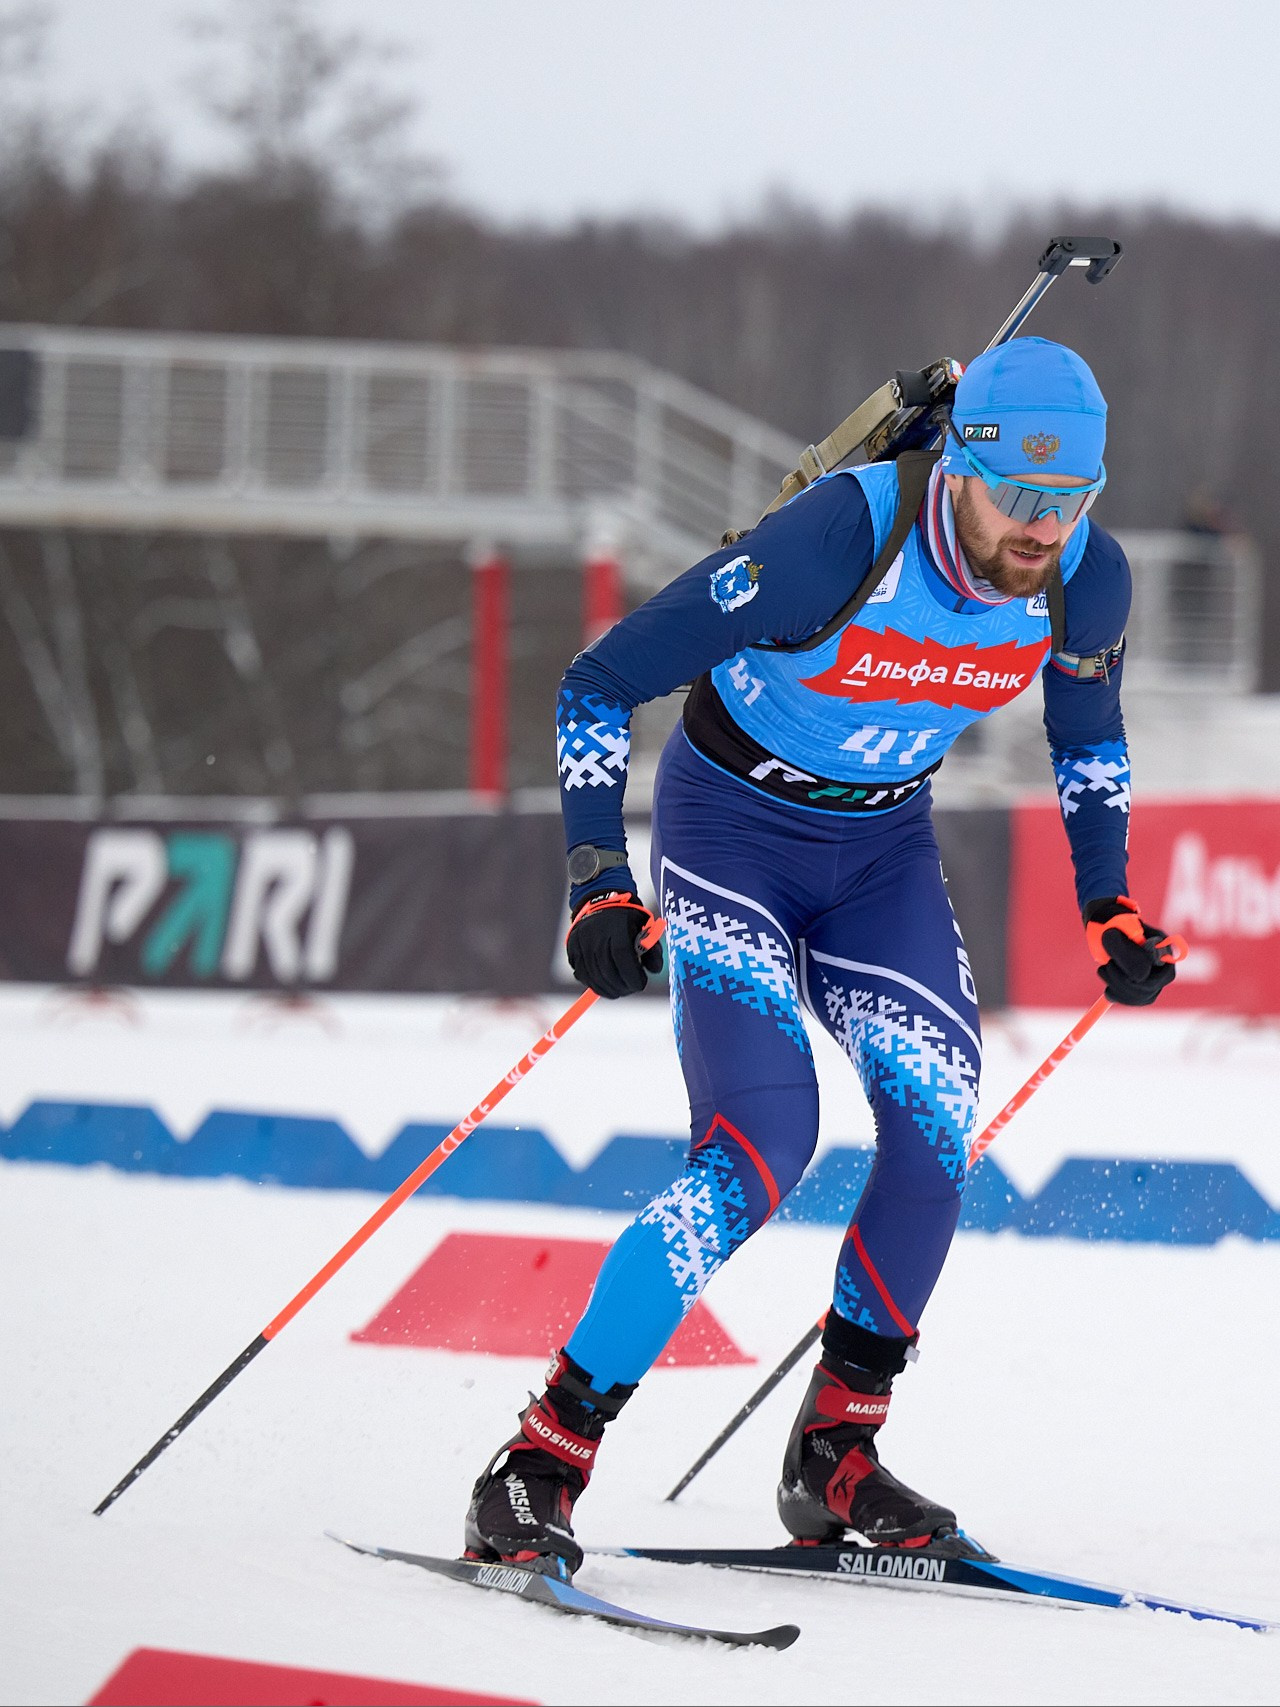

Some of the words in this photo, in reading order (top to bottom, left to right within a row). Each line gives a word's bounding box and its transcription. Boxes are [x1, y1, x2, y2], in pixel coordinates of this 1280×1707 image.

[965, 426, 998, 438] PARI
[728, 658, 766, 706] 41
[847, 653, 949, 687] Альфа
[952, 662, 1026, 690] Банк
[67, 826, 355, 980] PARI
[528, 1413, 593, 1460] MADSHUS
[473, 1566, 532, 1594] SALOMON
[837, 1552, 946, 1582] SALOMON
